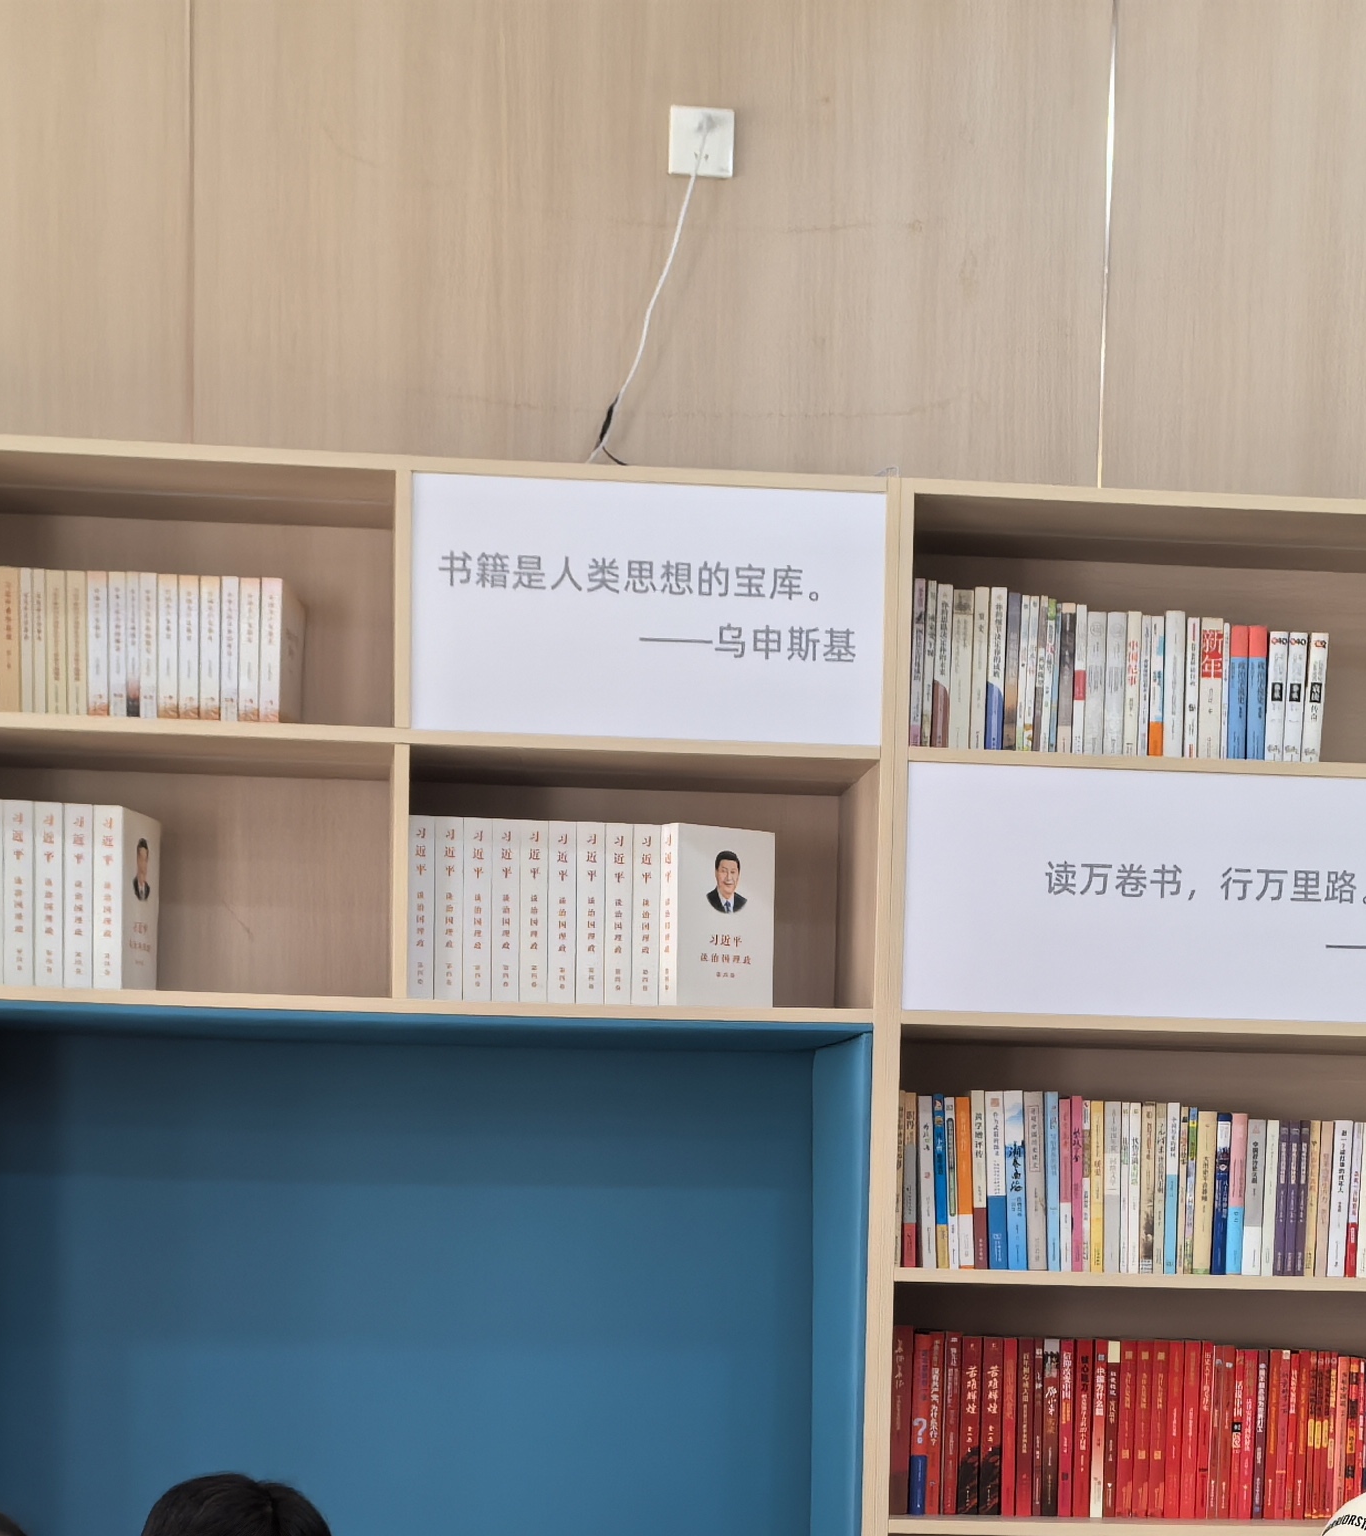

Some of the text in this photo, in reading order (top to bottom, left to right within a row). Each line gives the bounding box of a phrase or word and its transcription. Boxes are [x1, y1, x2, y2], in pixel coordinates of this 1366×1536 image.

[438, 551, 819, 602] 书籍是人类思想的宝库。
[1202, 629, 1223, 678] 新年
[709, 934, 742, 947] 习近平
